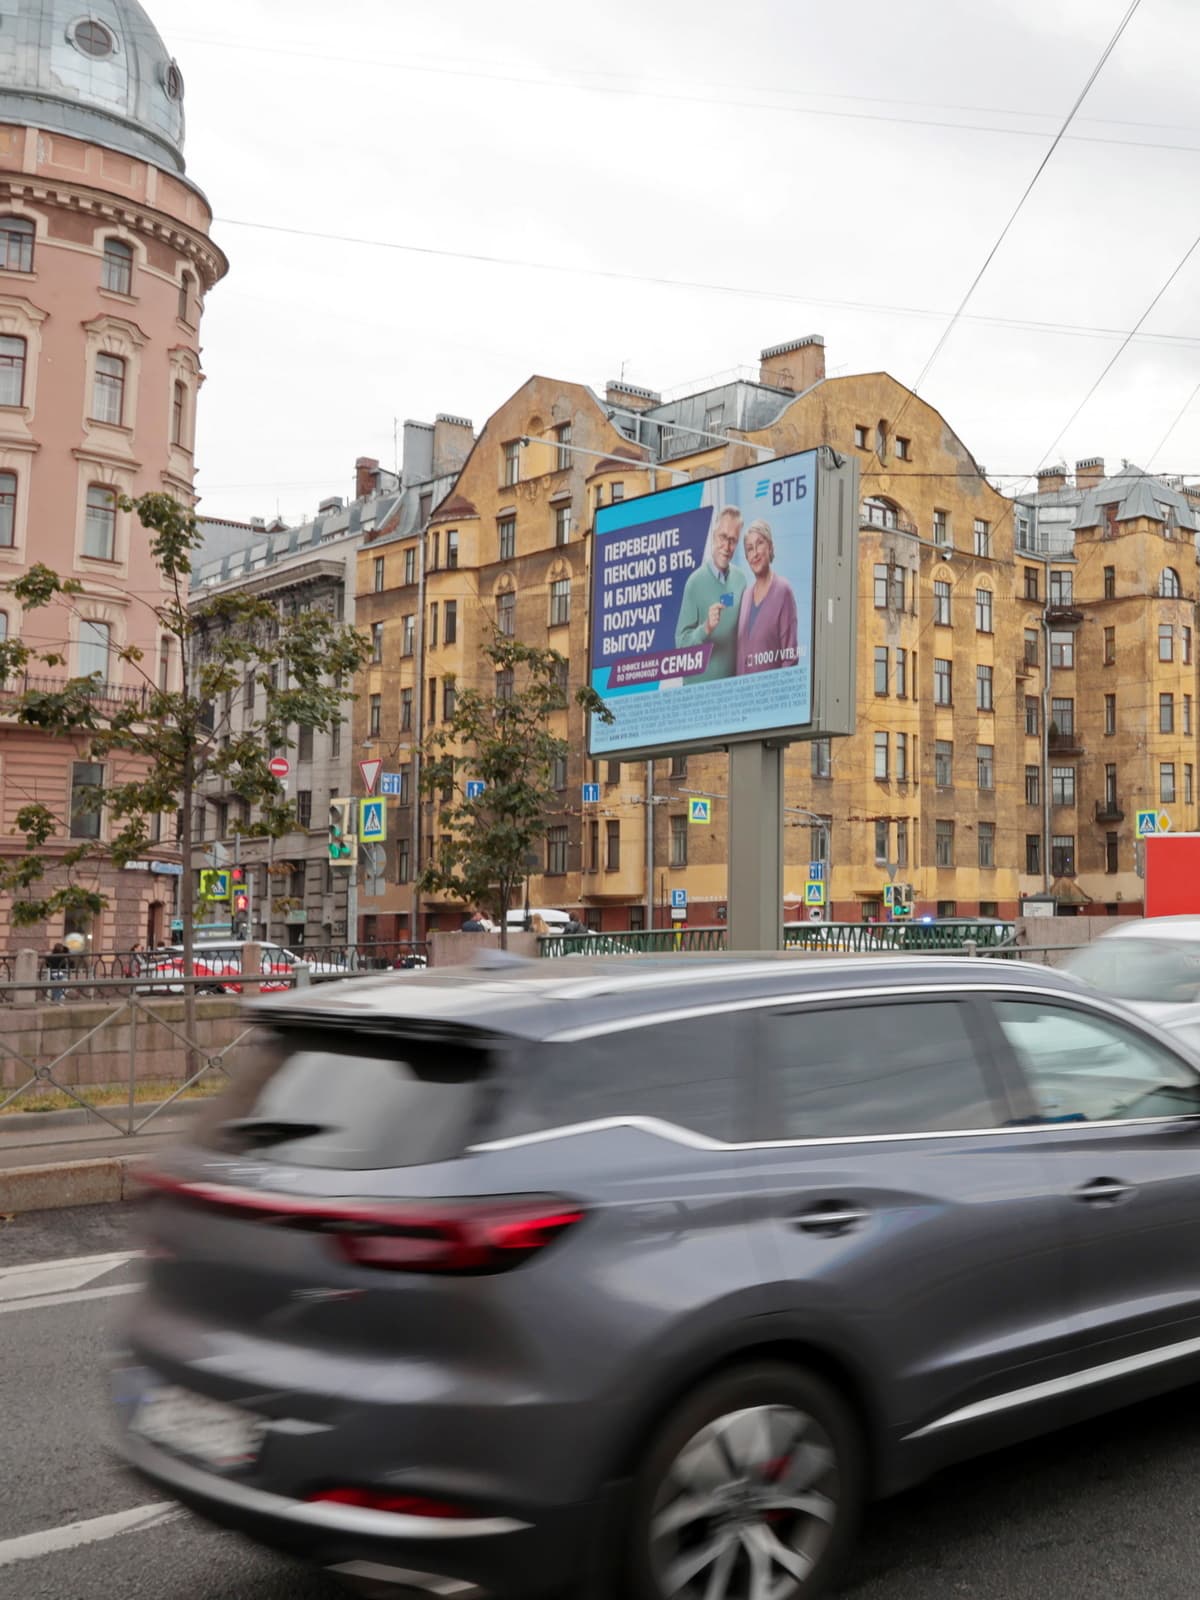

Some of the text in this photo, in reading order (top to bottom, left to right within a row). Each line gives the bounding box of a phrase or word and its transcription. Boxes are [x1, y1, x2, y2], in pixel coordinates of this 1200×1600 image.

[772, 474, 807, 506] ВТБ
[604, 528, 680, 563] ПЕРЕВЕДИТЕ
[604, 549, 696, 585] ПЕНСИЮ В ВТБ,
[604, 578, 673, 609] И БЛИЗКИЕ
[603, 604, 662, 632] ПОЛУЧАТ
[602, 629, 655, 656] ВЫГОДУ
[621, 662, 641, 673] ОФИСЕ
[641, 658, 660, 669] БАНКА
[661, 651, 703, 676] СЕМЬЯ
[754, 650, 774, 665] 1000
